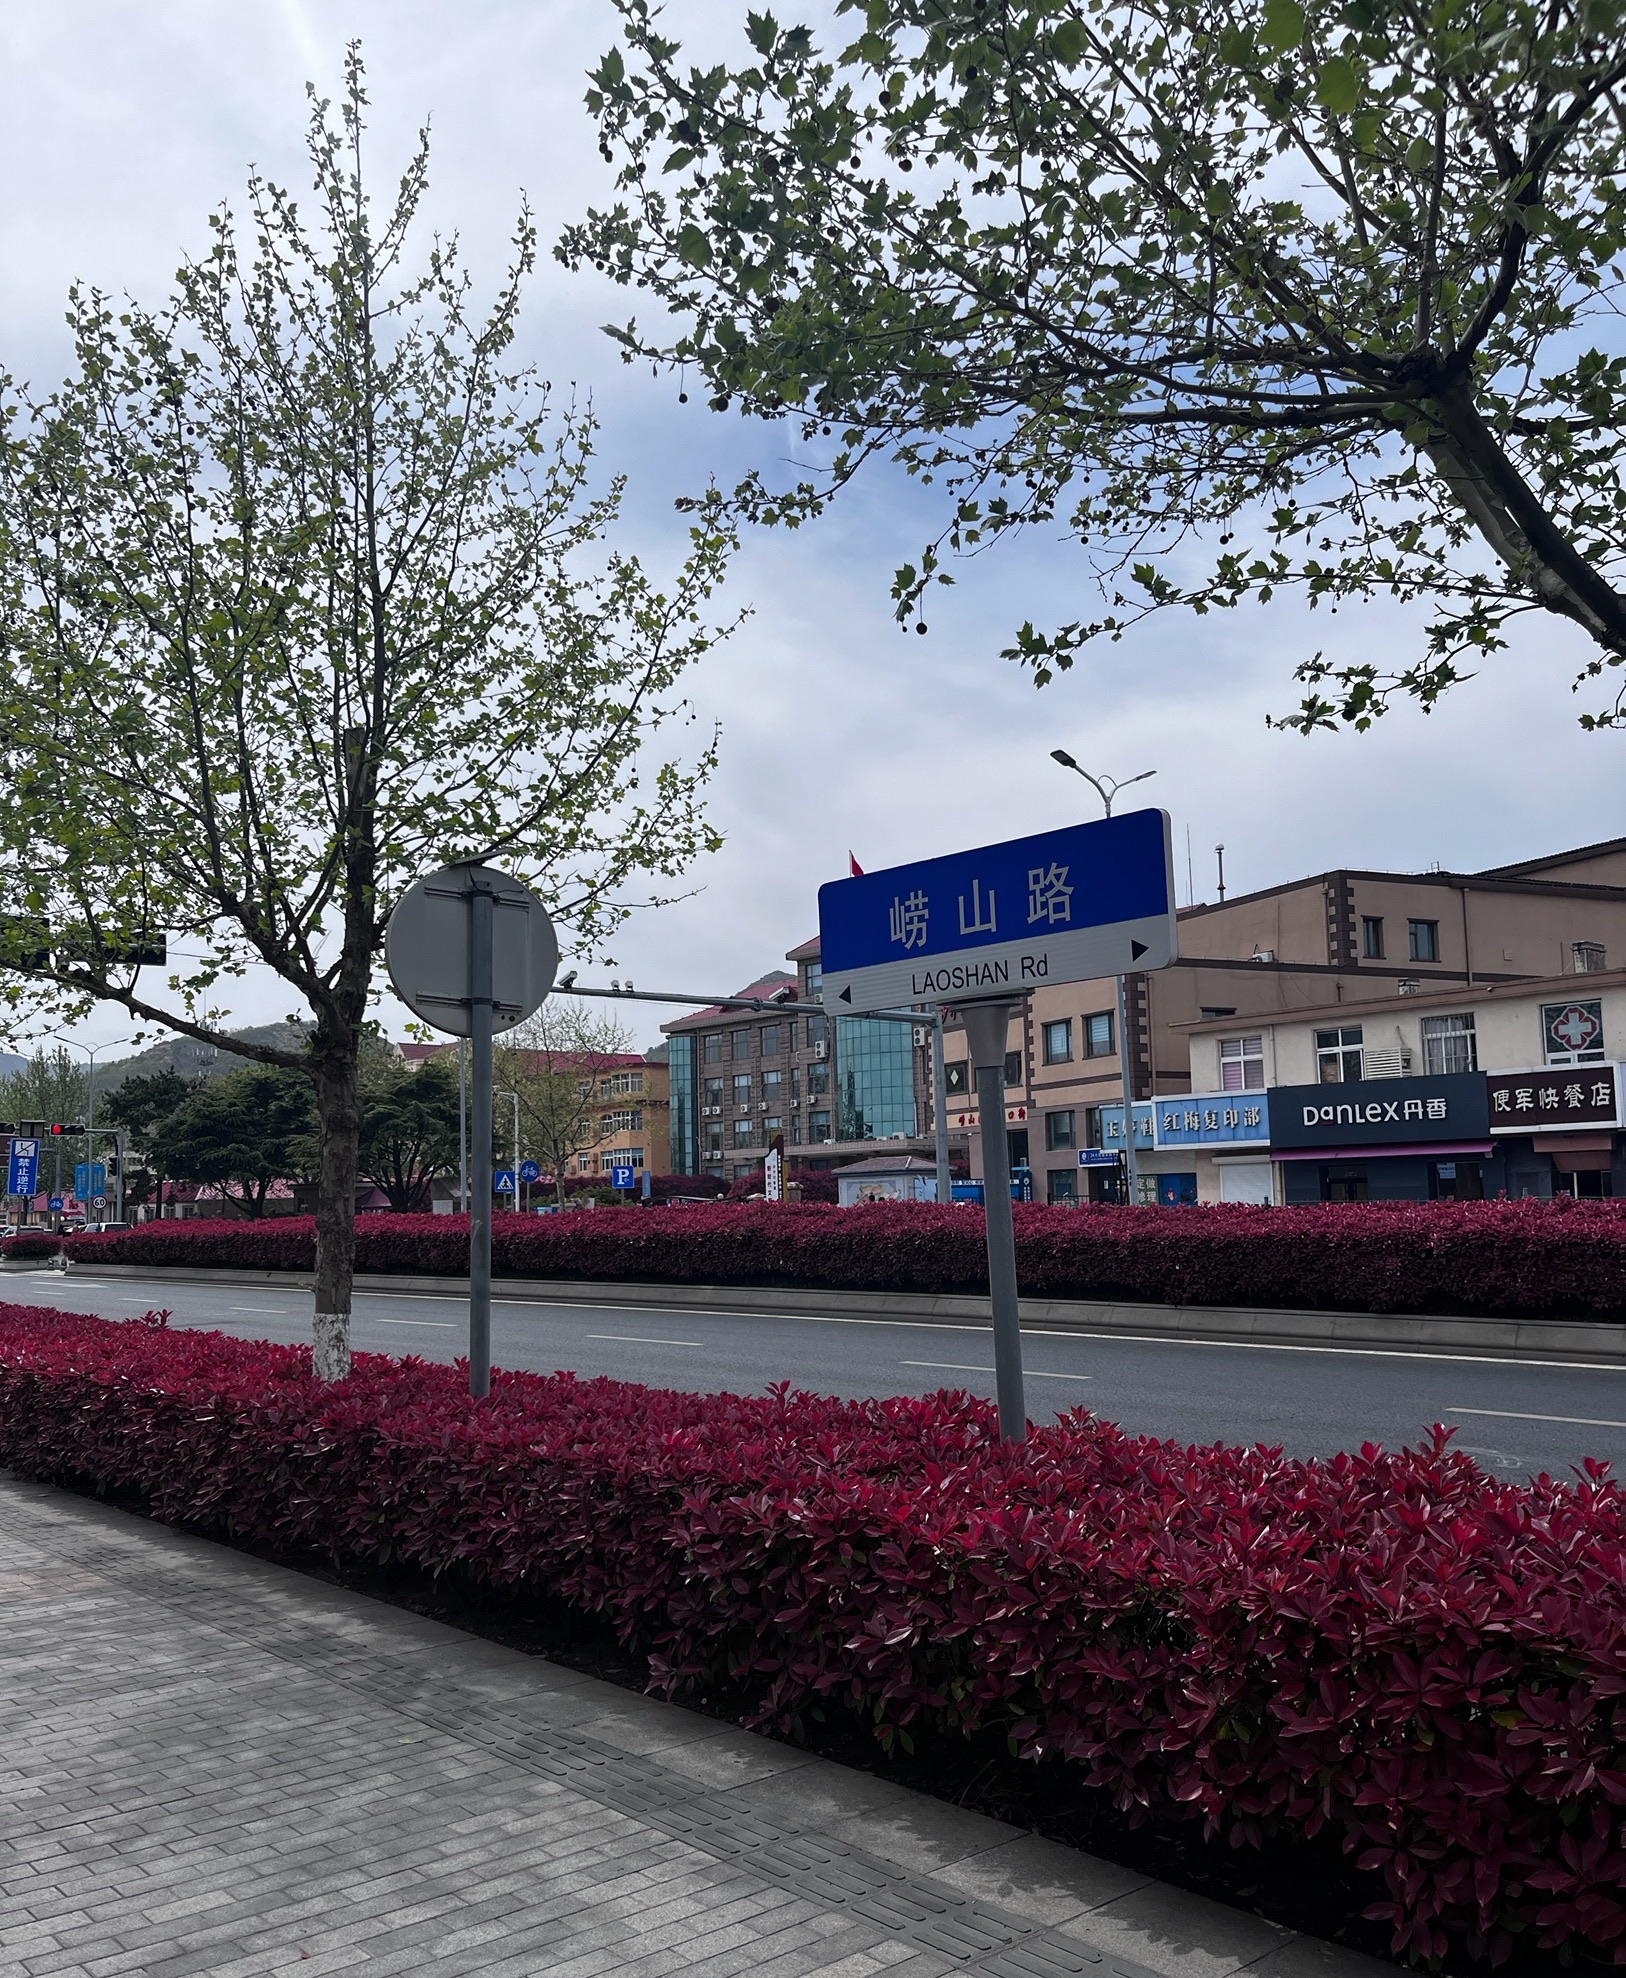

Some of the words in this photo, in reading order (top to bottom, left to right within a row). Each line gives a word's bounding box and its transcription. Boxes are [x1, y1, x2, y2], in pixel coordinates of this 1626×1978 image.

[889, 862, 1074, 950] 崂山路
[912, 959, 1009, 995] LAOSHAN
[1021, 954, 1048, 980] Rd
[1403, 1098, 1448, 1120] 丹香
[1492, 1081, 1611, 1114] 便军快餐店
[1163, 1107, 1260, 1132] 红梅复印部
[16, 1158, 30, 1193] 禁止逆行
[616, 1168, 630, 1185] P
